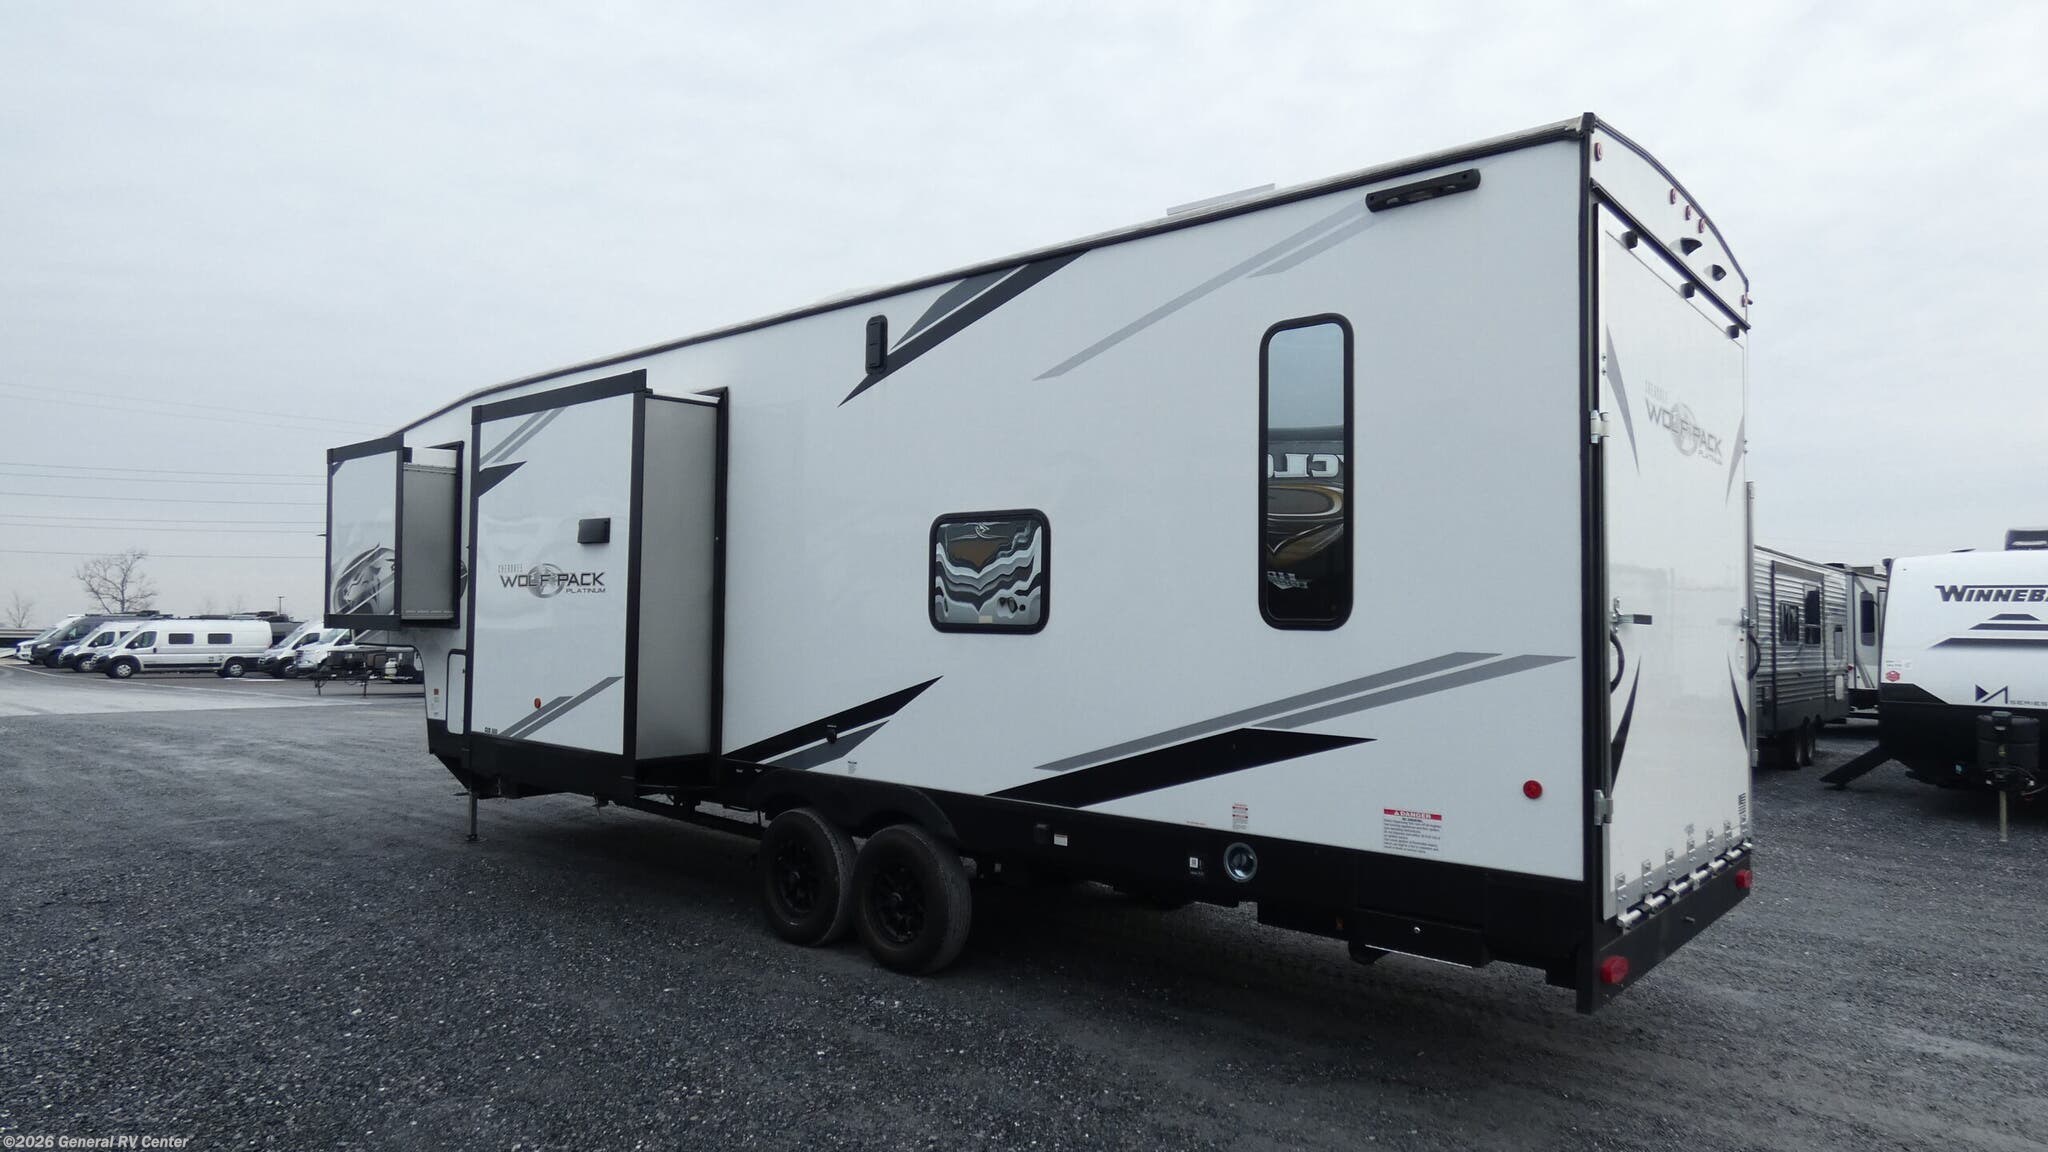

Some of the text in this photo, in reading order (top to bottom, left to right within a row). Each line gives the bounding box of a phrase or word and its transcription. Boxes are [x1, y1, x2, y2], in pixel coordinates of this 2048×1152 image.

[500, 572, 605, 588] WOLF PACK
[1935, 585, 2048, 602] WINNEB
[1400, 811, 1431, 819] DANGER
